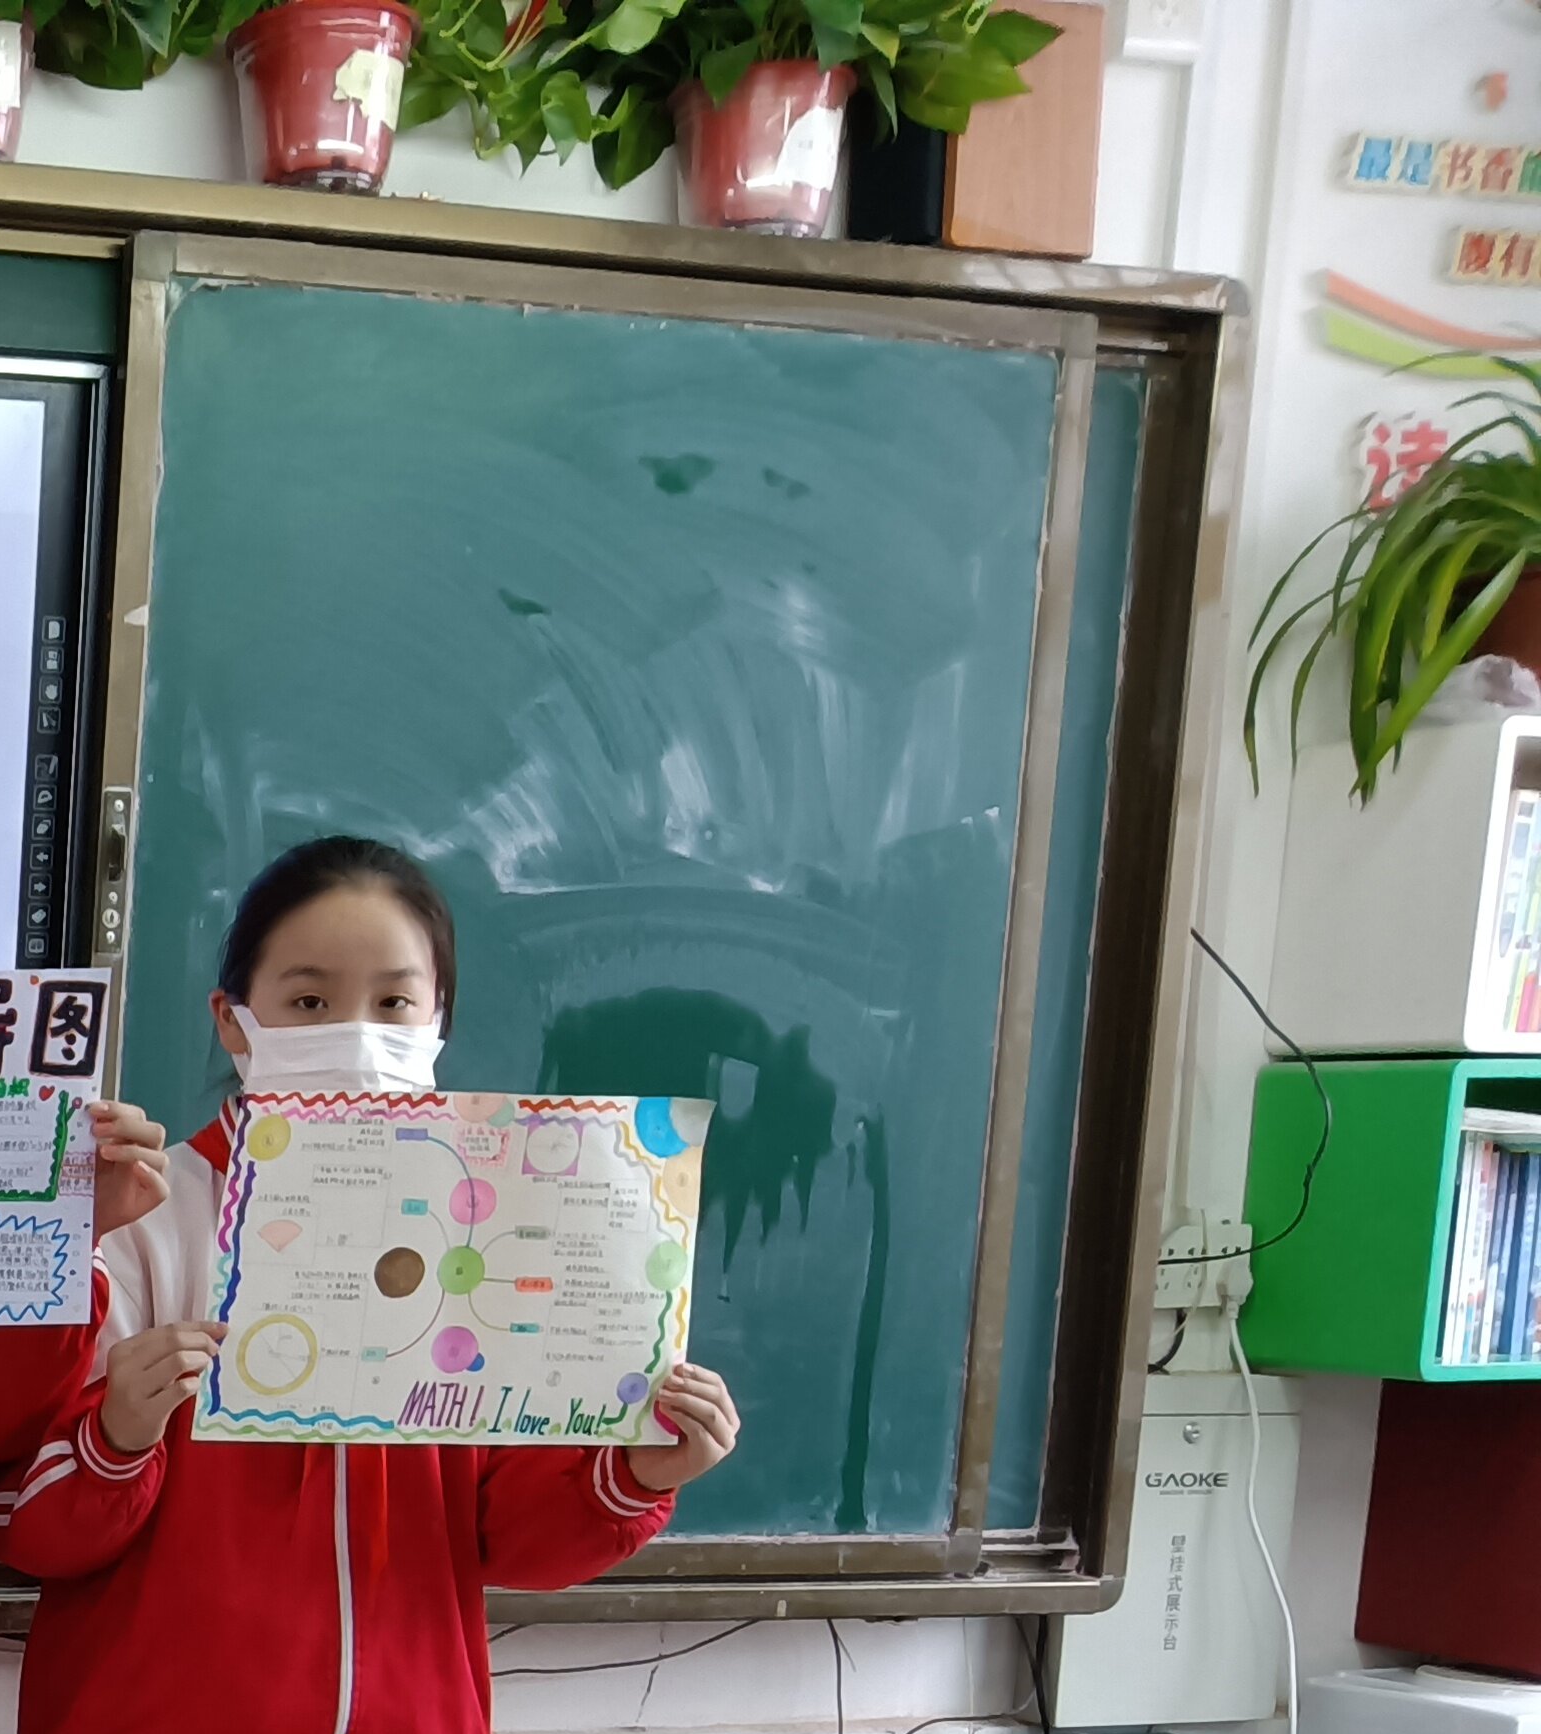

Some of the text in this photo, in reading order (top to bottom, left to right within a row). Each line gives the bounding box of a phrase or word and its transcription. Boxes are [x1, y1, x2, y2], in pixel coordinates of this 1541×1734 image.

[488, 1385, 513, 1433] I
[514, 1386, 551, 1436] love
[1145, 1472, 1230, 1488] GAOKE
